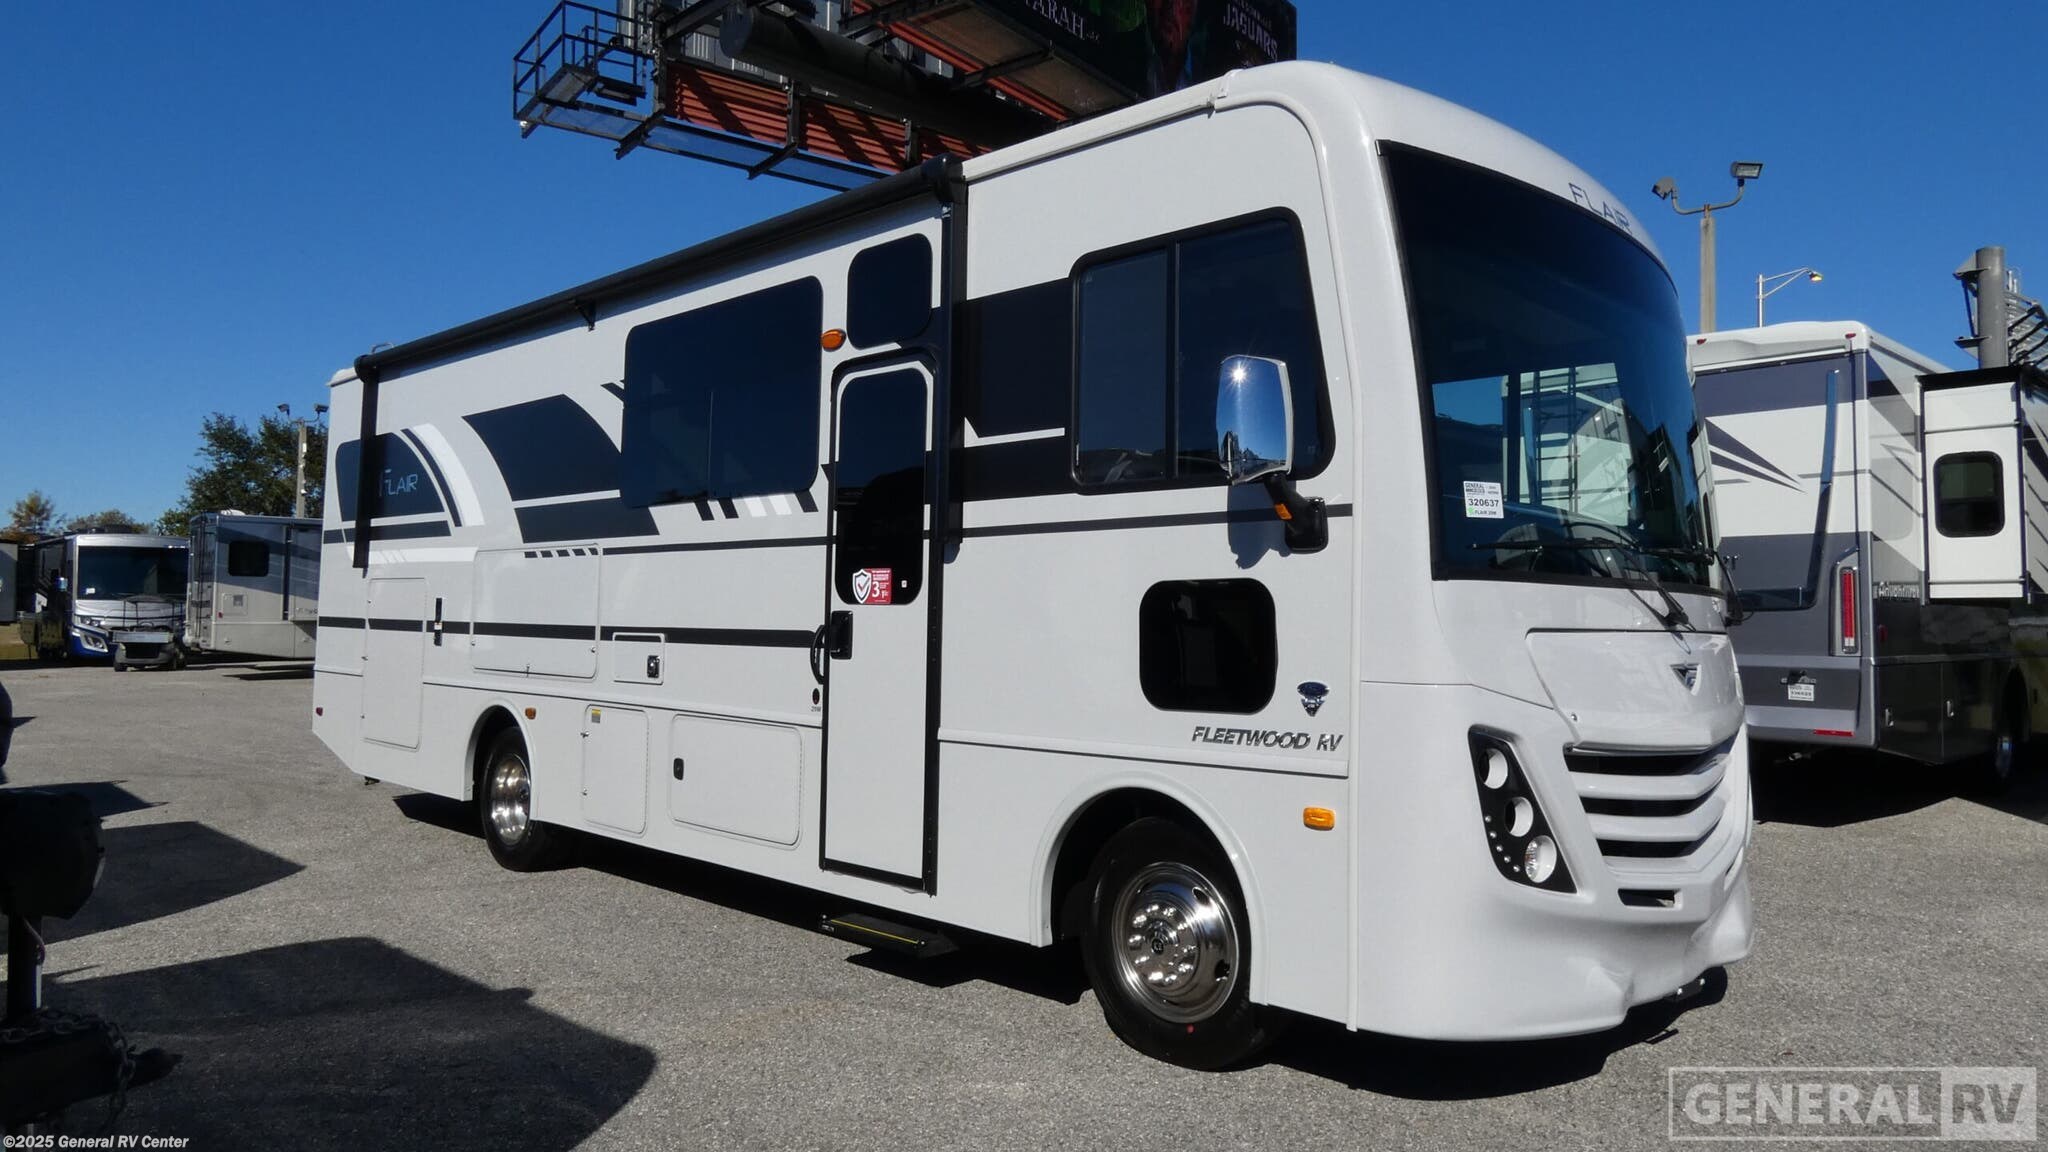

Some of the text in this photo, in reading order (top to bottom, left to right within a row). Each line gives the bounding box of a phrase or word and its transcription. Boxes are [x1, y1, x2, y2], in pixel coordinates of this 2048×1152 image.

[1025, 0, 1085, 40] ARAH
[1468, 498, 1499, 507] 320637
[872, 581, 880, 598] 3
[1192, 726, 1343, 751] FLEETWOOD RV
